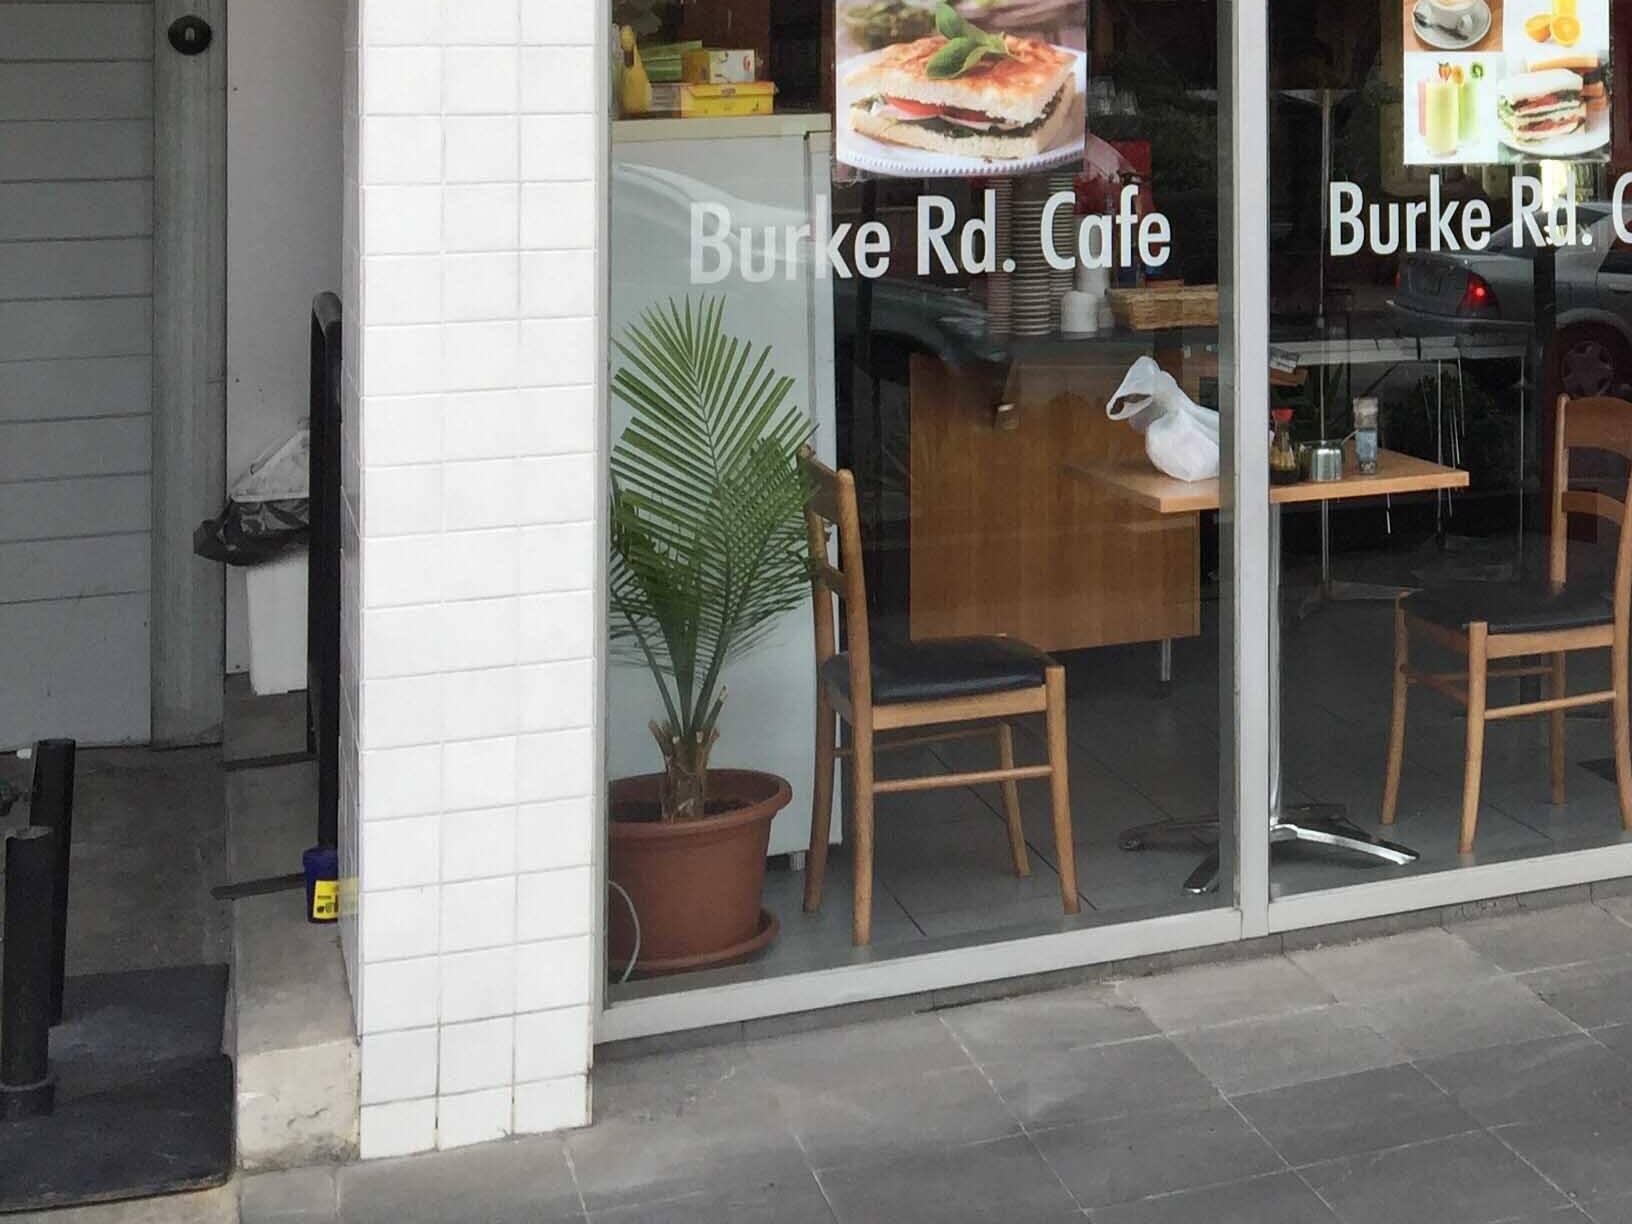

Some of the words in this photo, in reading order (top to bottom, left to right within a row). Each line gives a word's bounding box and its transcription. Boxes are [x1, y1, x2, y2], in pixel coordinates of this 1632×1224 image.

[690, 194, 891, 285] Burke
[917, 189, 1016, 276] Rd.
[1041, 183, 1171, 270] Cafe
[1330, 173, 1492, 256] Burke
[1511, 174, 1593, 248] Rd.
